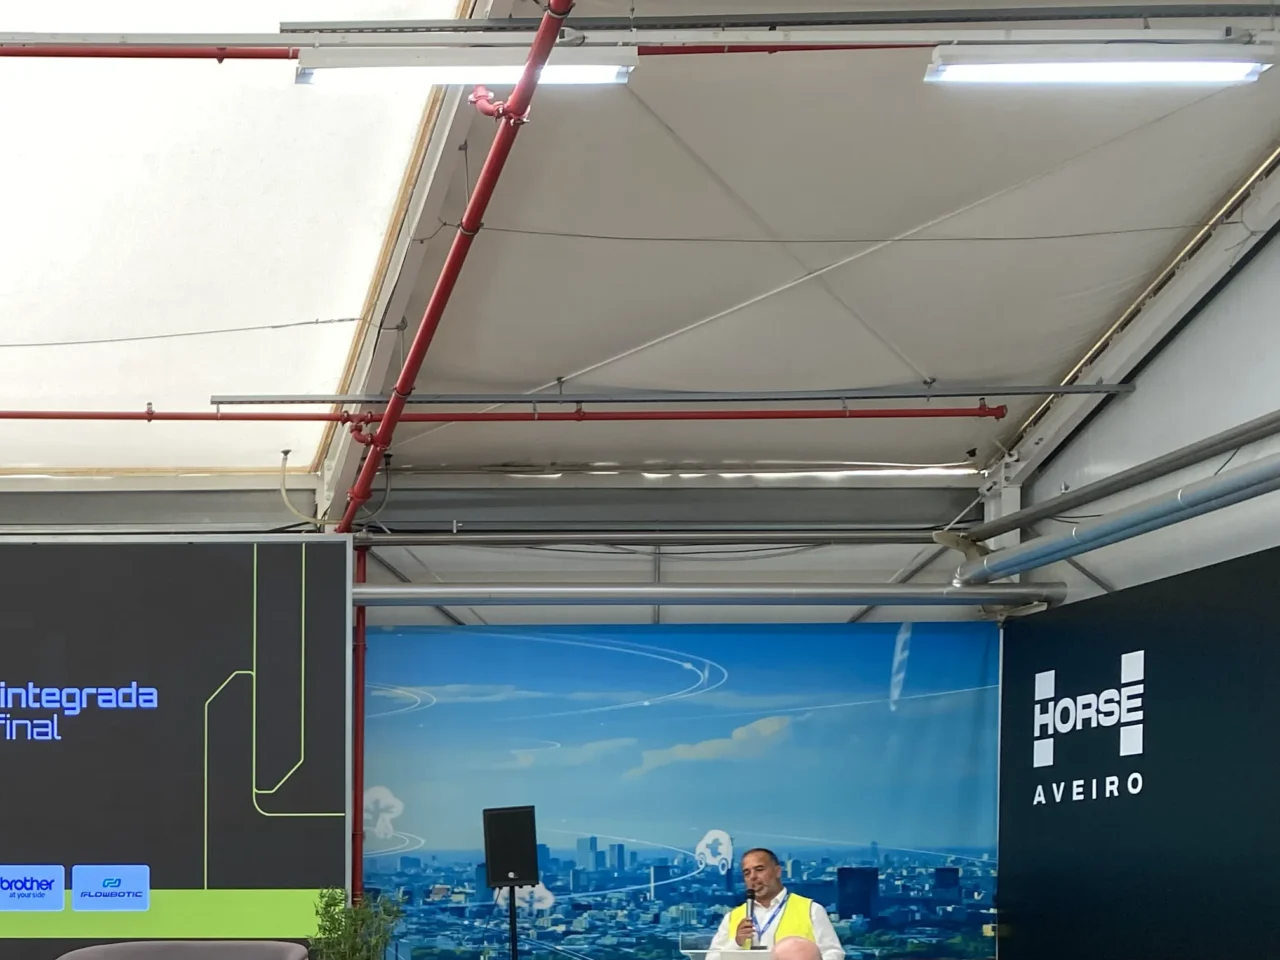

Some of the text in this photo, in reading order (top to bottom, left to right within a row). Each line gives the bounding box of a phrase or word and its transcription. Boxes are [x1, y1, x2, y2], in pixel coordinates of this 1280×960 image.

[0, 681, 158, 716] integrada
[1033, 684, 1144, 737] HORSE
[1033, 772, 1143, 805] AVEIRO
[0, 876, 55, 891] brother
